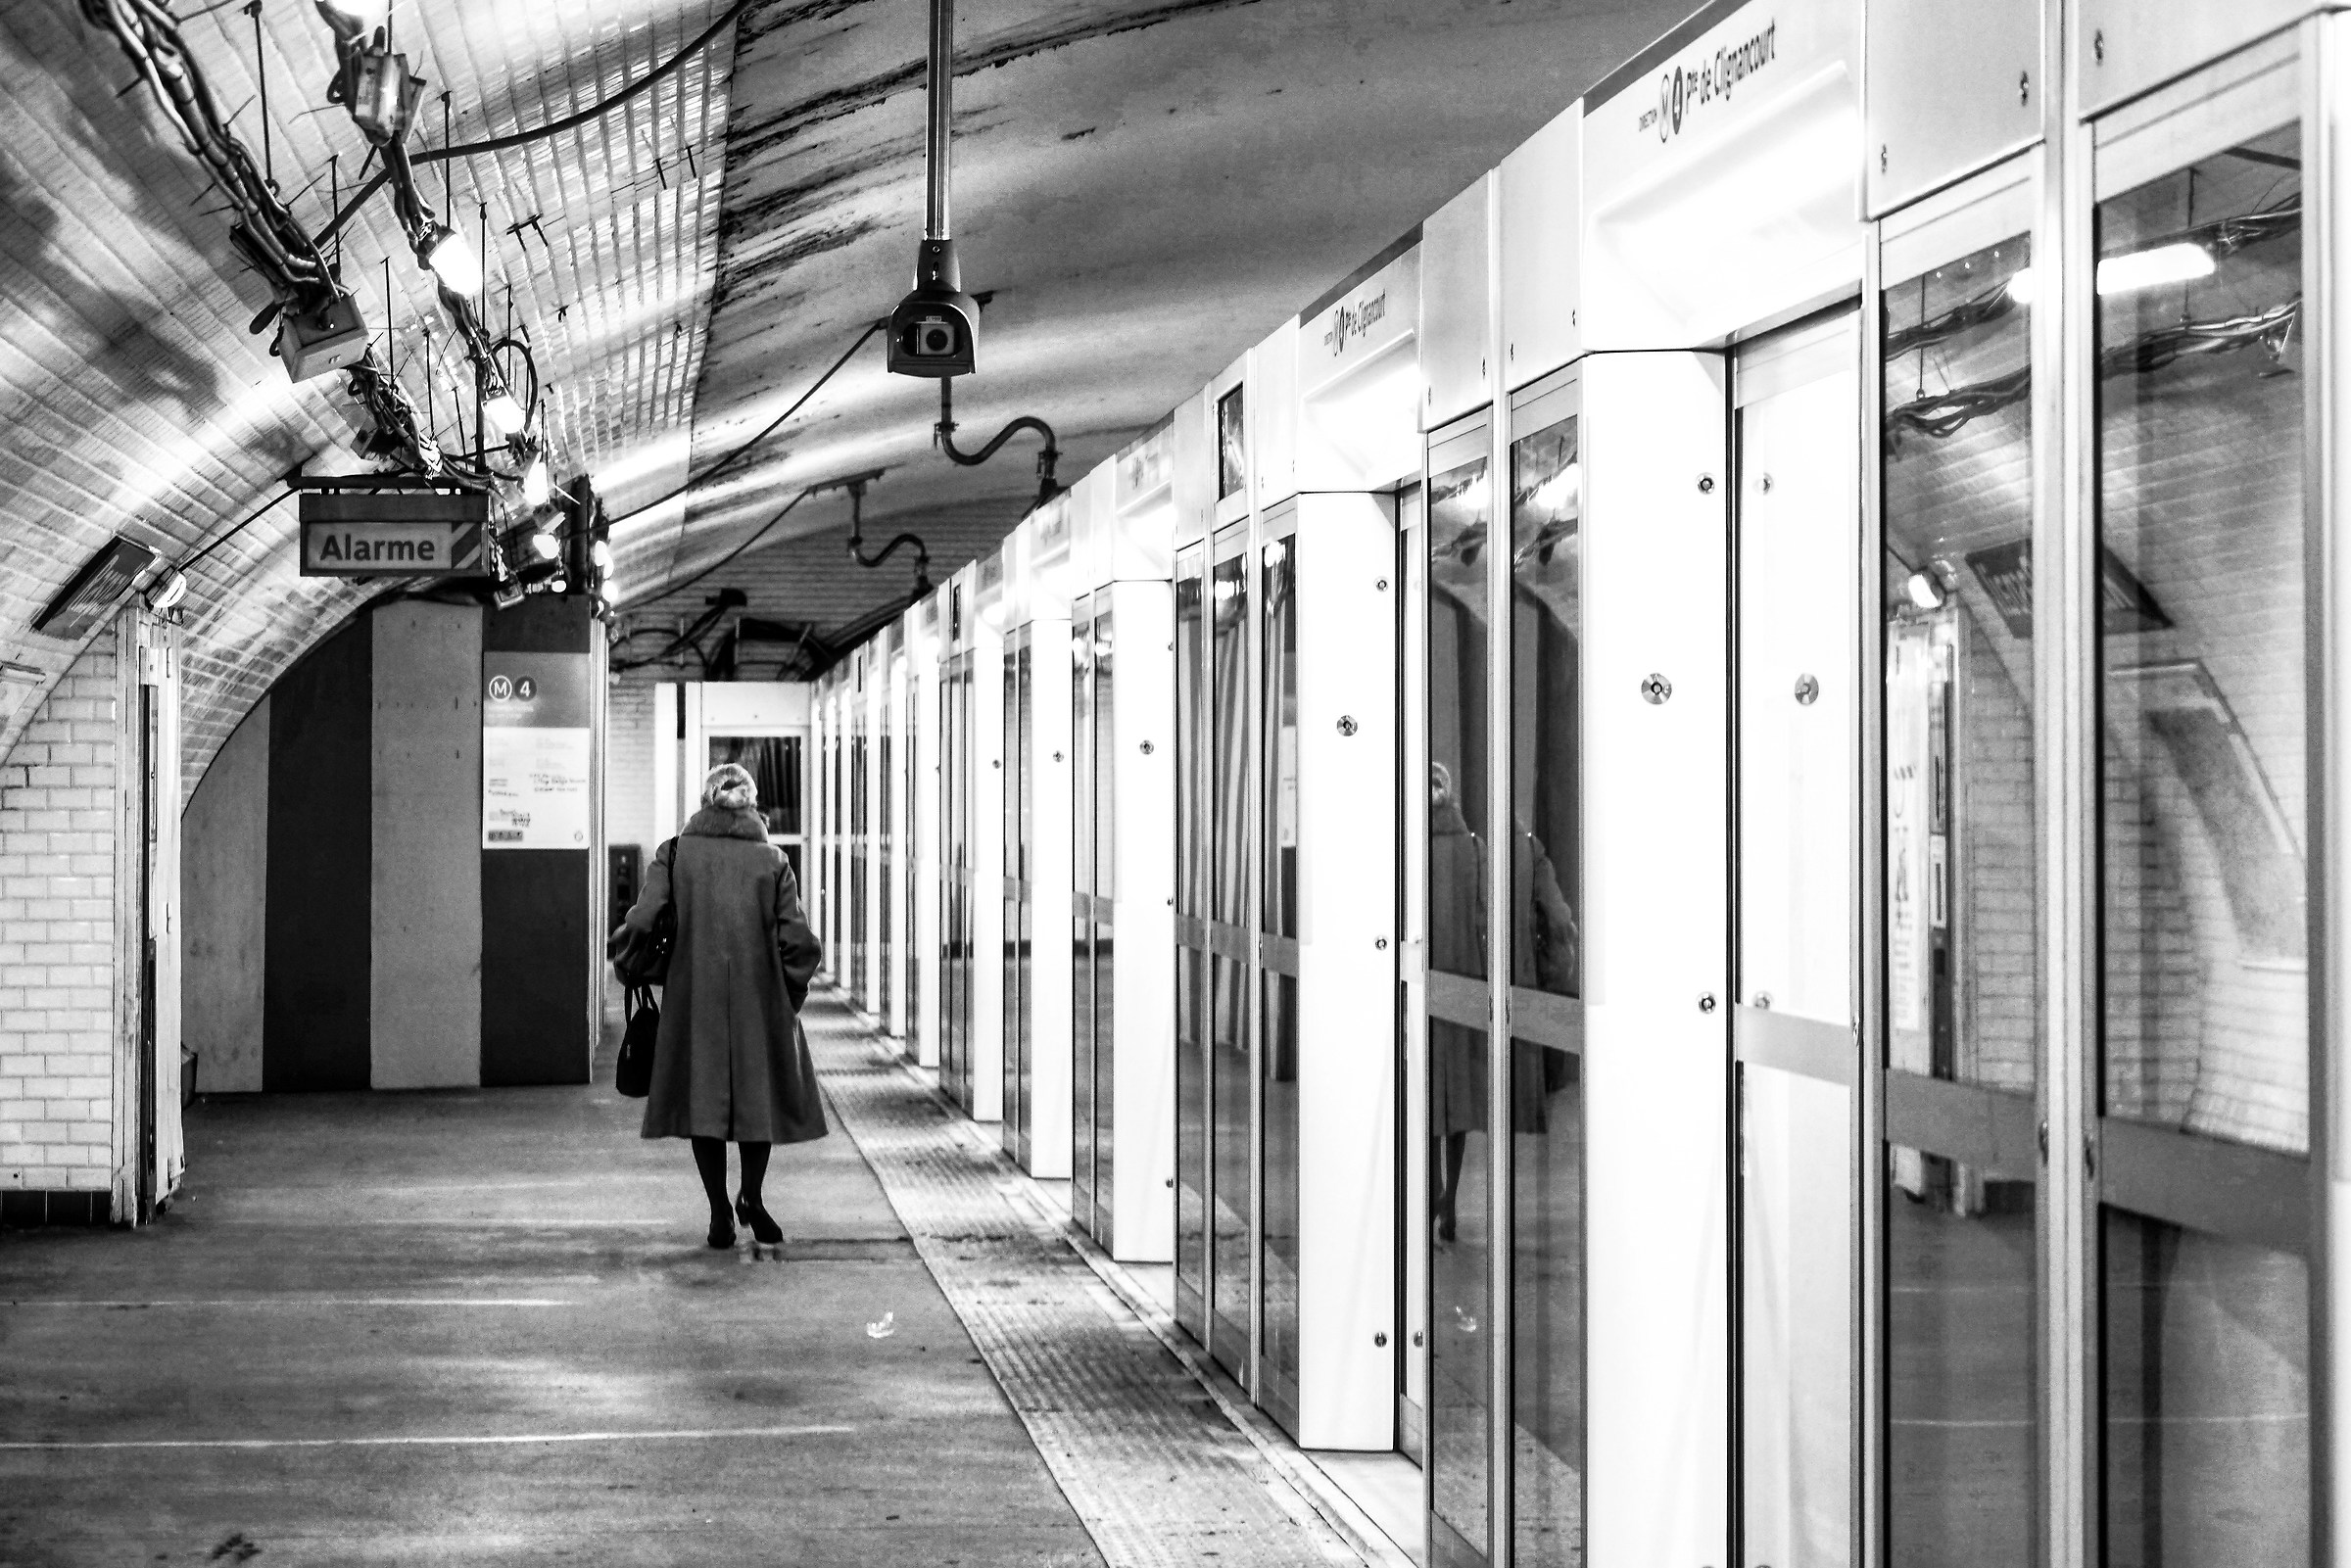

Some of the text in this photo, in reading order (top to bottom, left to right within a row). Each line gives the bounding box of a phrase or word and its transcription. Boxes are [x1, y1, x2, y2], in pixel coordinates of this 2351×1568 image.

[1701, 60, 1711, 105] de
[1714, 18, 1776, 101] Clignancourt
[319, 533, 435, 561] Alarme
